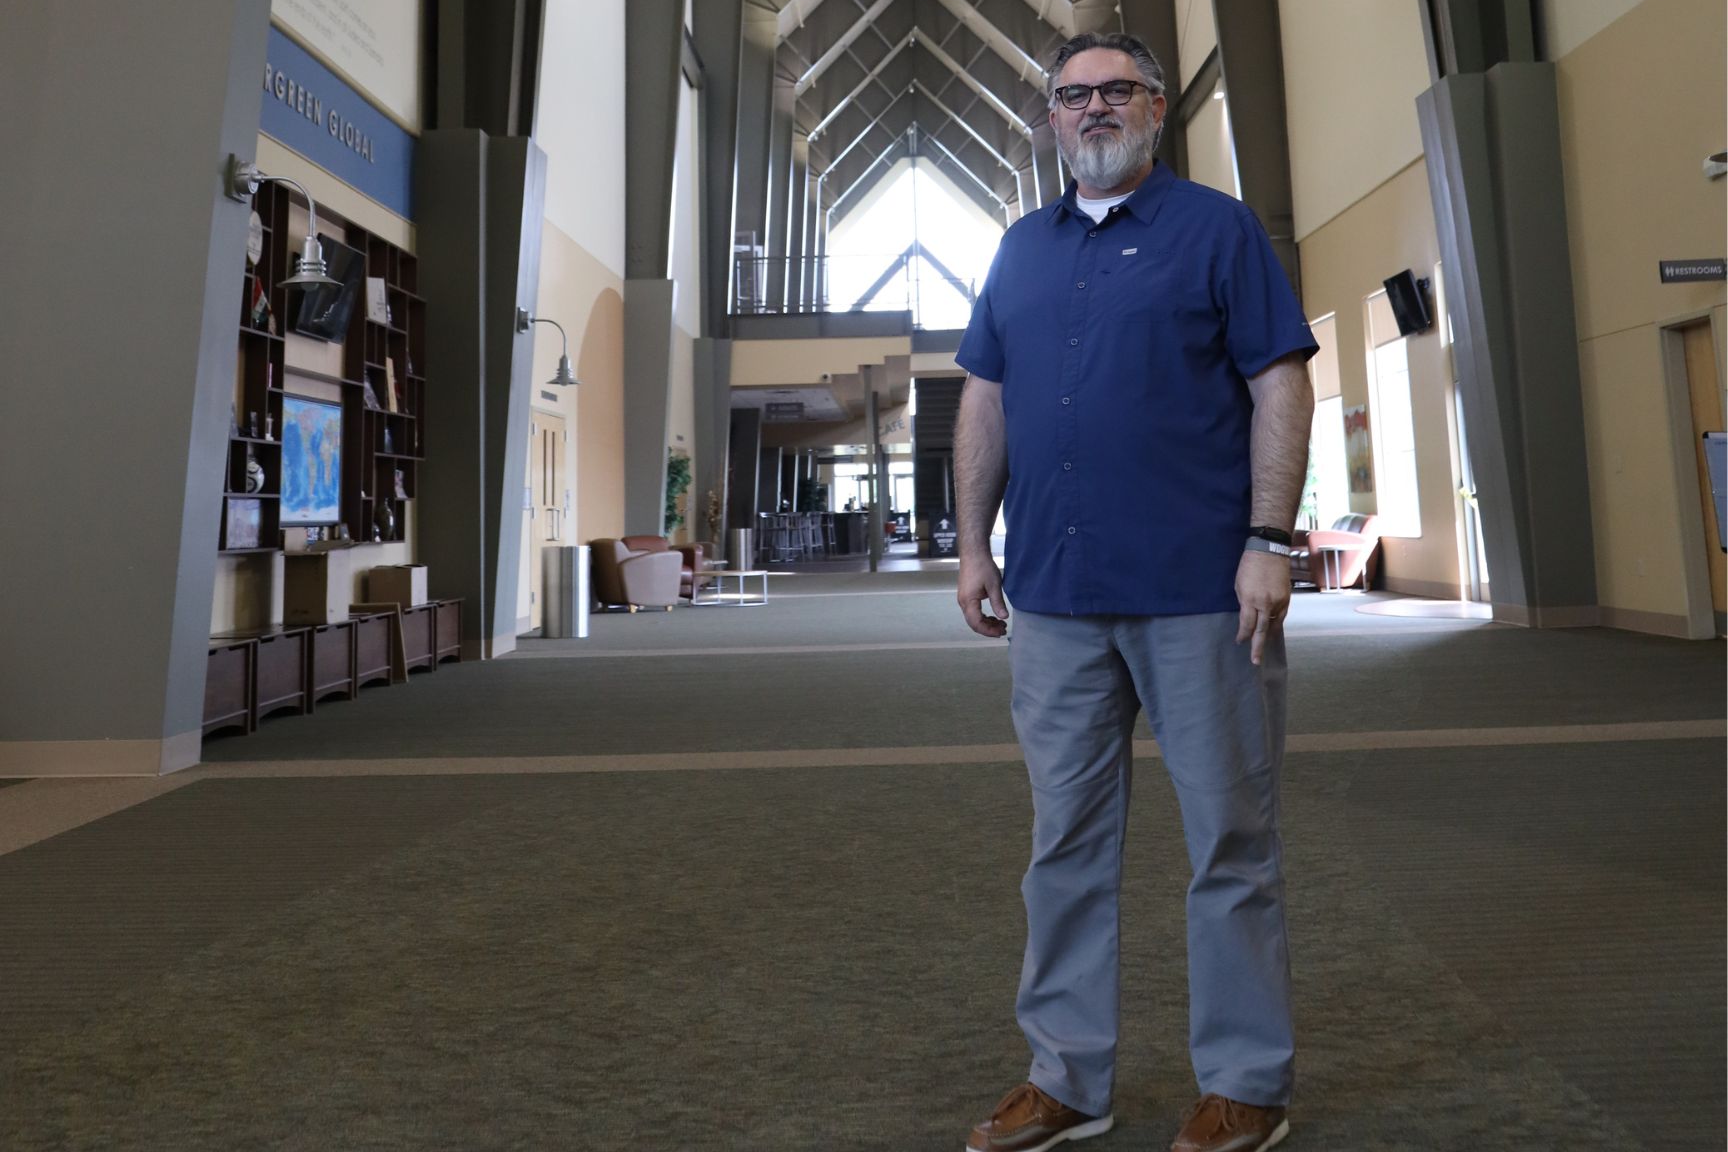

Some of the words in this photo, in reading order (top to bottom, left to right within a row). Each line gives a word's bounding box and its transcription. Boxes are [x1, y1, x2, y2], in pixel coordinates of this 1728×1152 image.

[264, 62, 322, 126] RGREEN
[328, 109, 375, 164] GLOBAL
[1674, 265, 1722, 276] RESTROOMS
